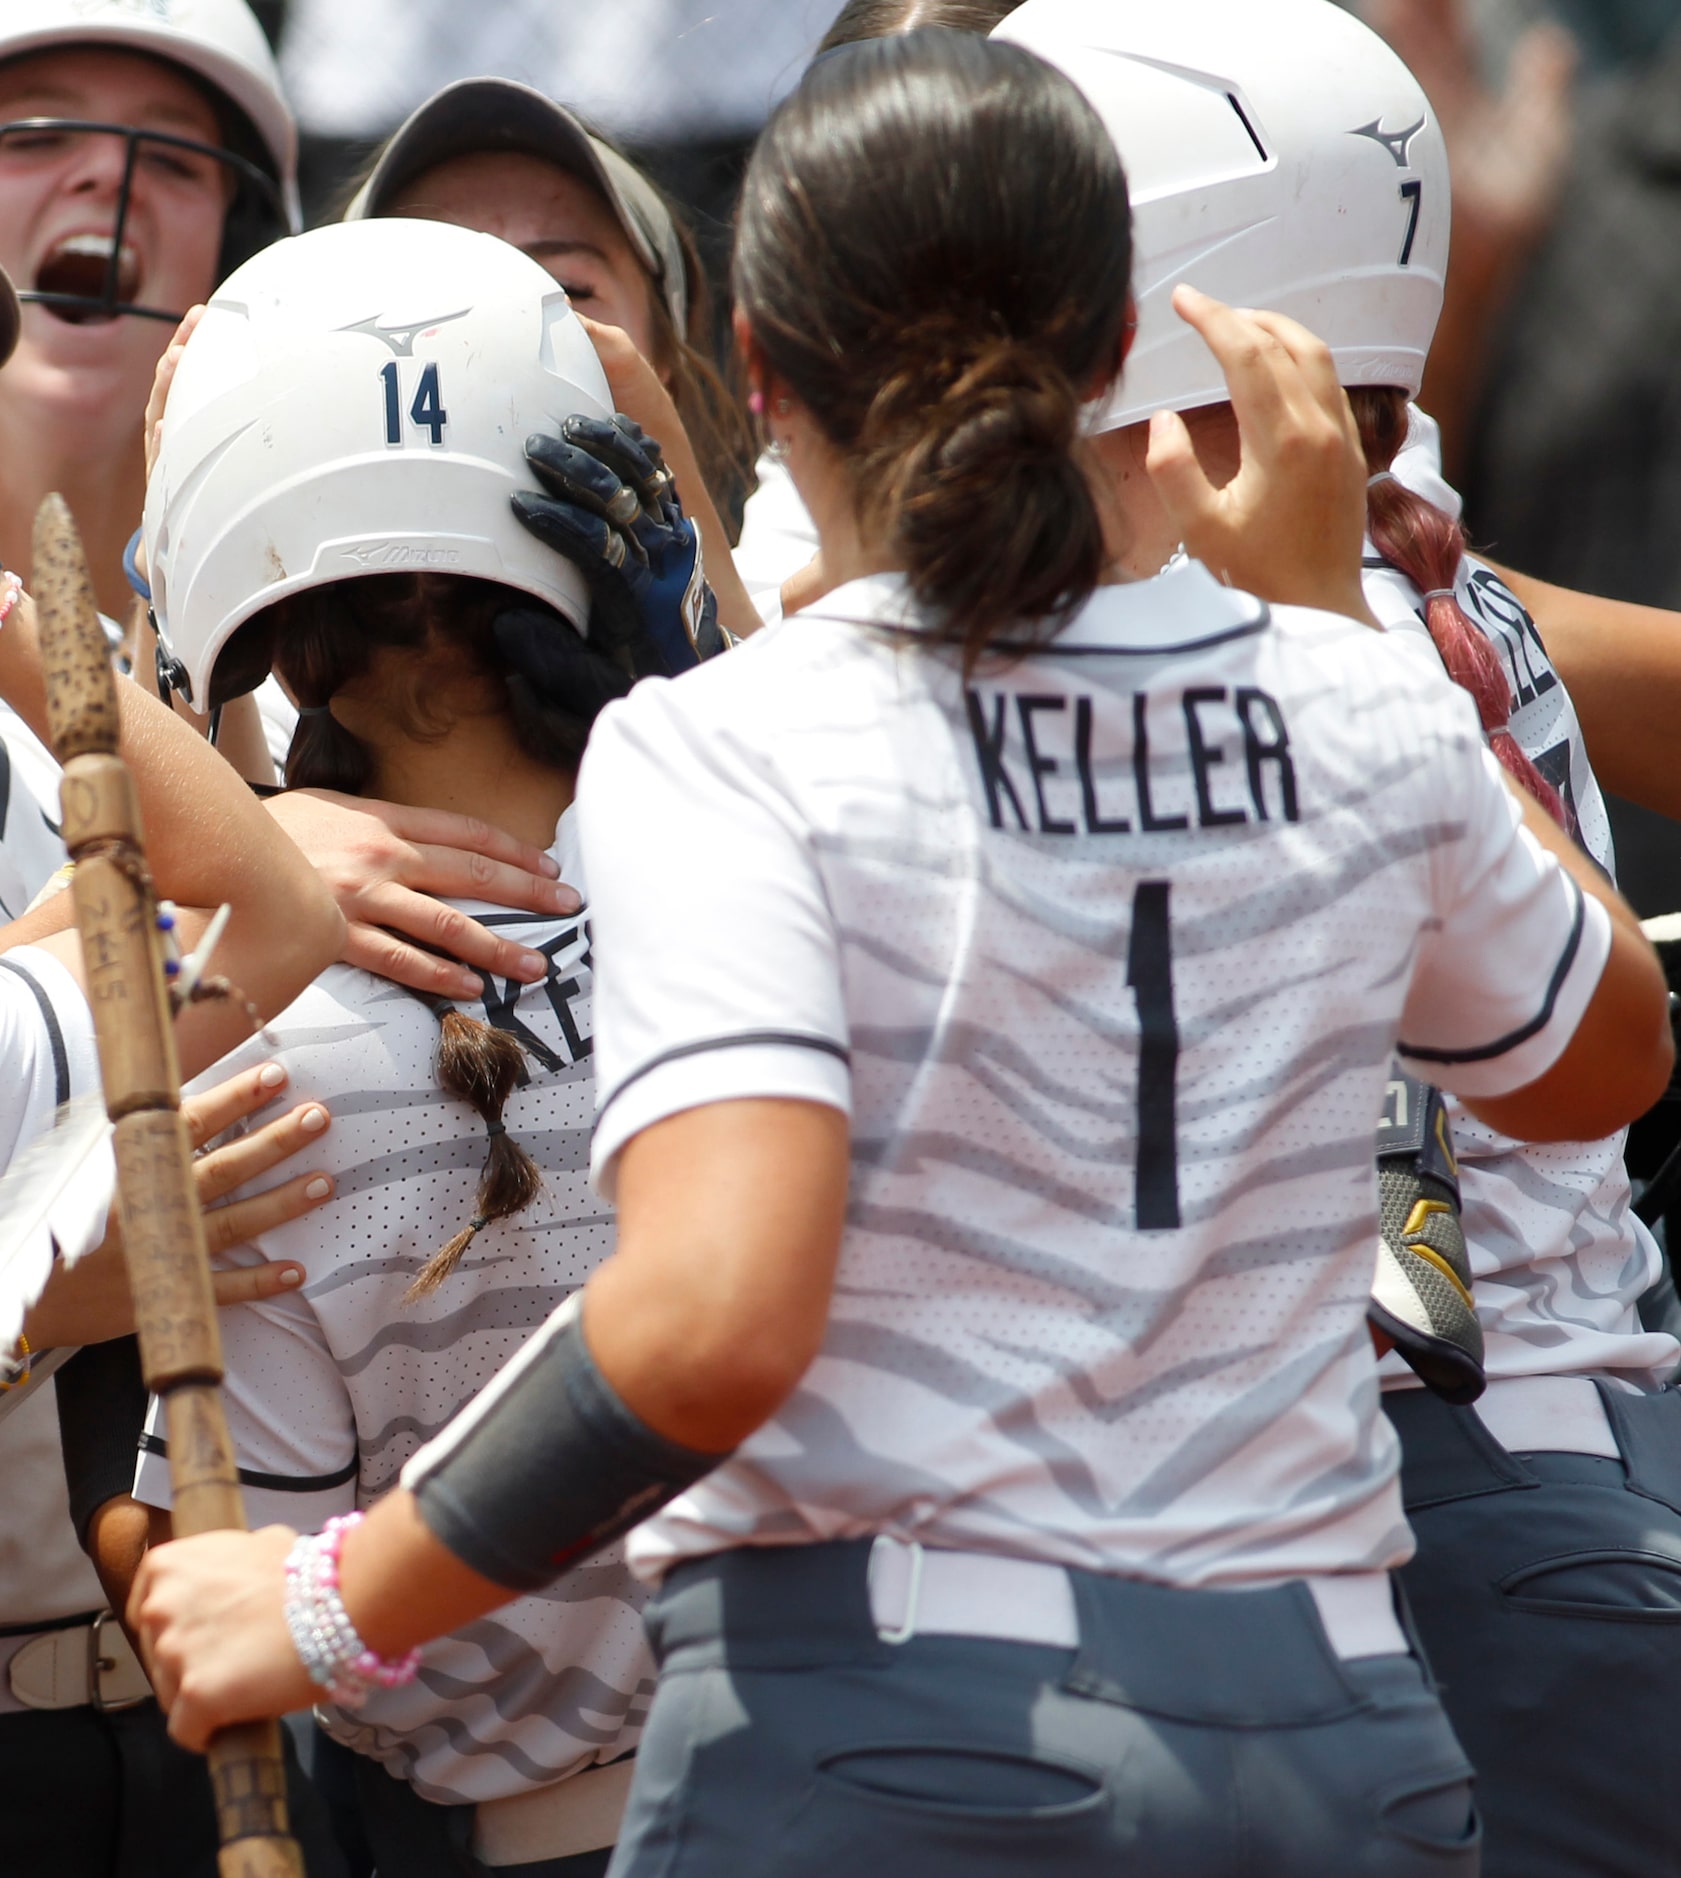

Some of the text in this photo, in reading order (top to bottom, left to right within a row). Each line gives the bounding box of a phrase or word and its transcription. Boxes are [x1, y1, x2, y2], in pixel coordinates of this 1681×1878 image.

[1401, 180, 1421, 265] 7
[381, 362, 446, 443] 14
[963, 686, 1300, 834] KELLER
[1126, 880, 1180, 1230] 1
